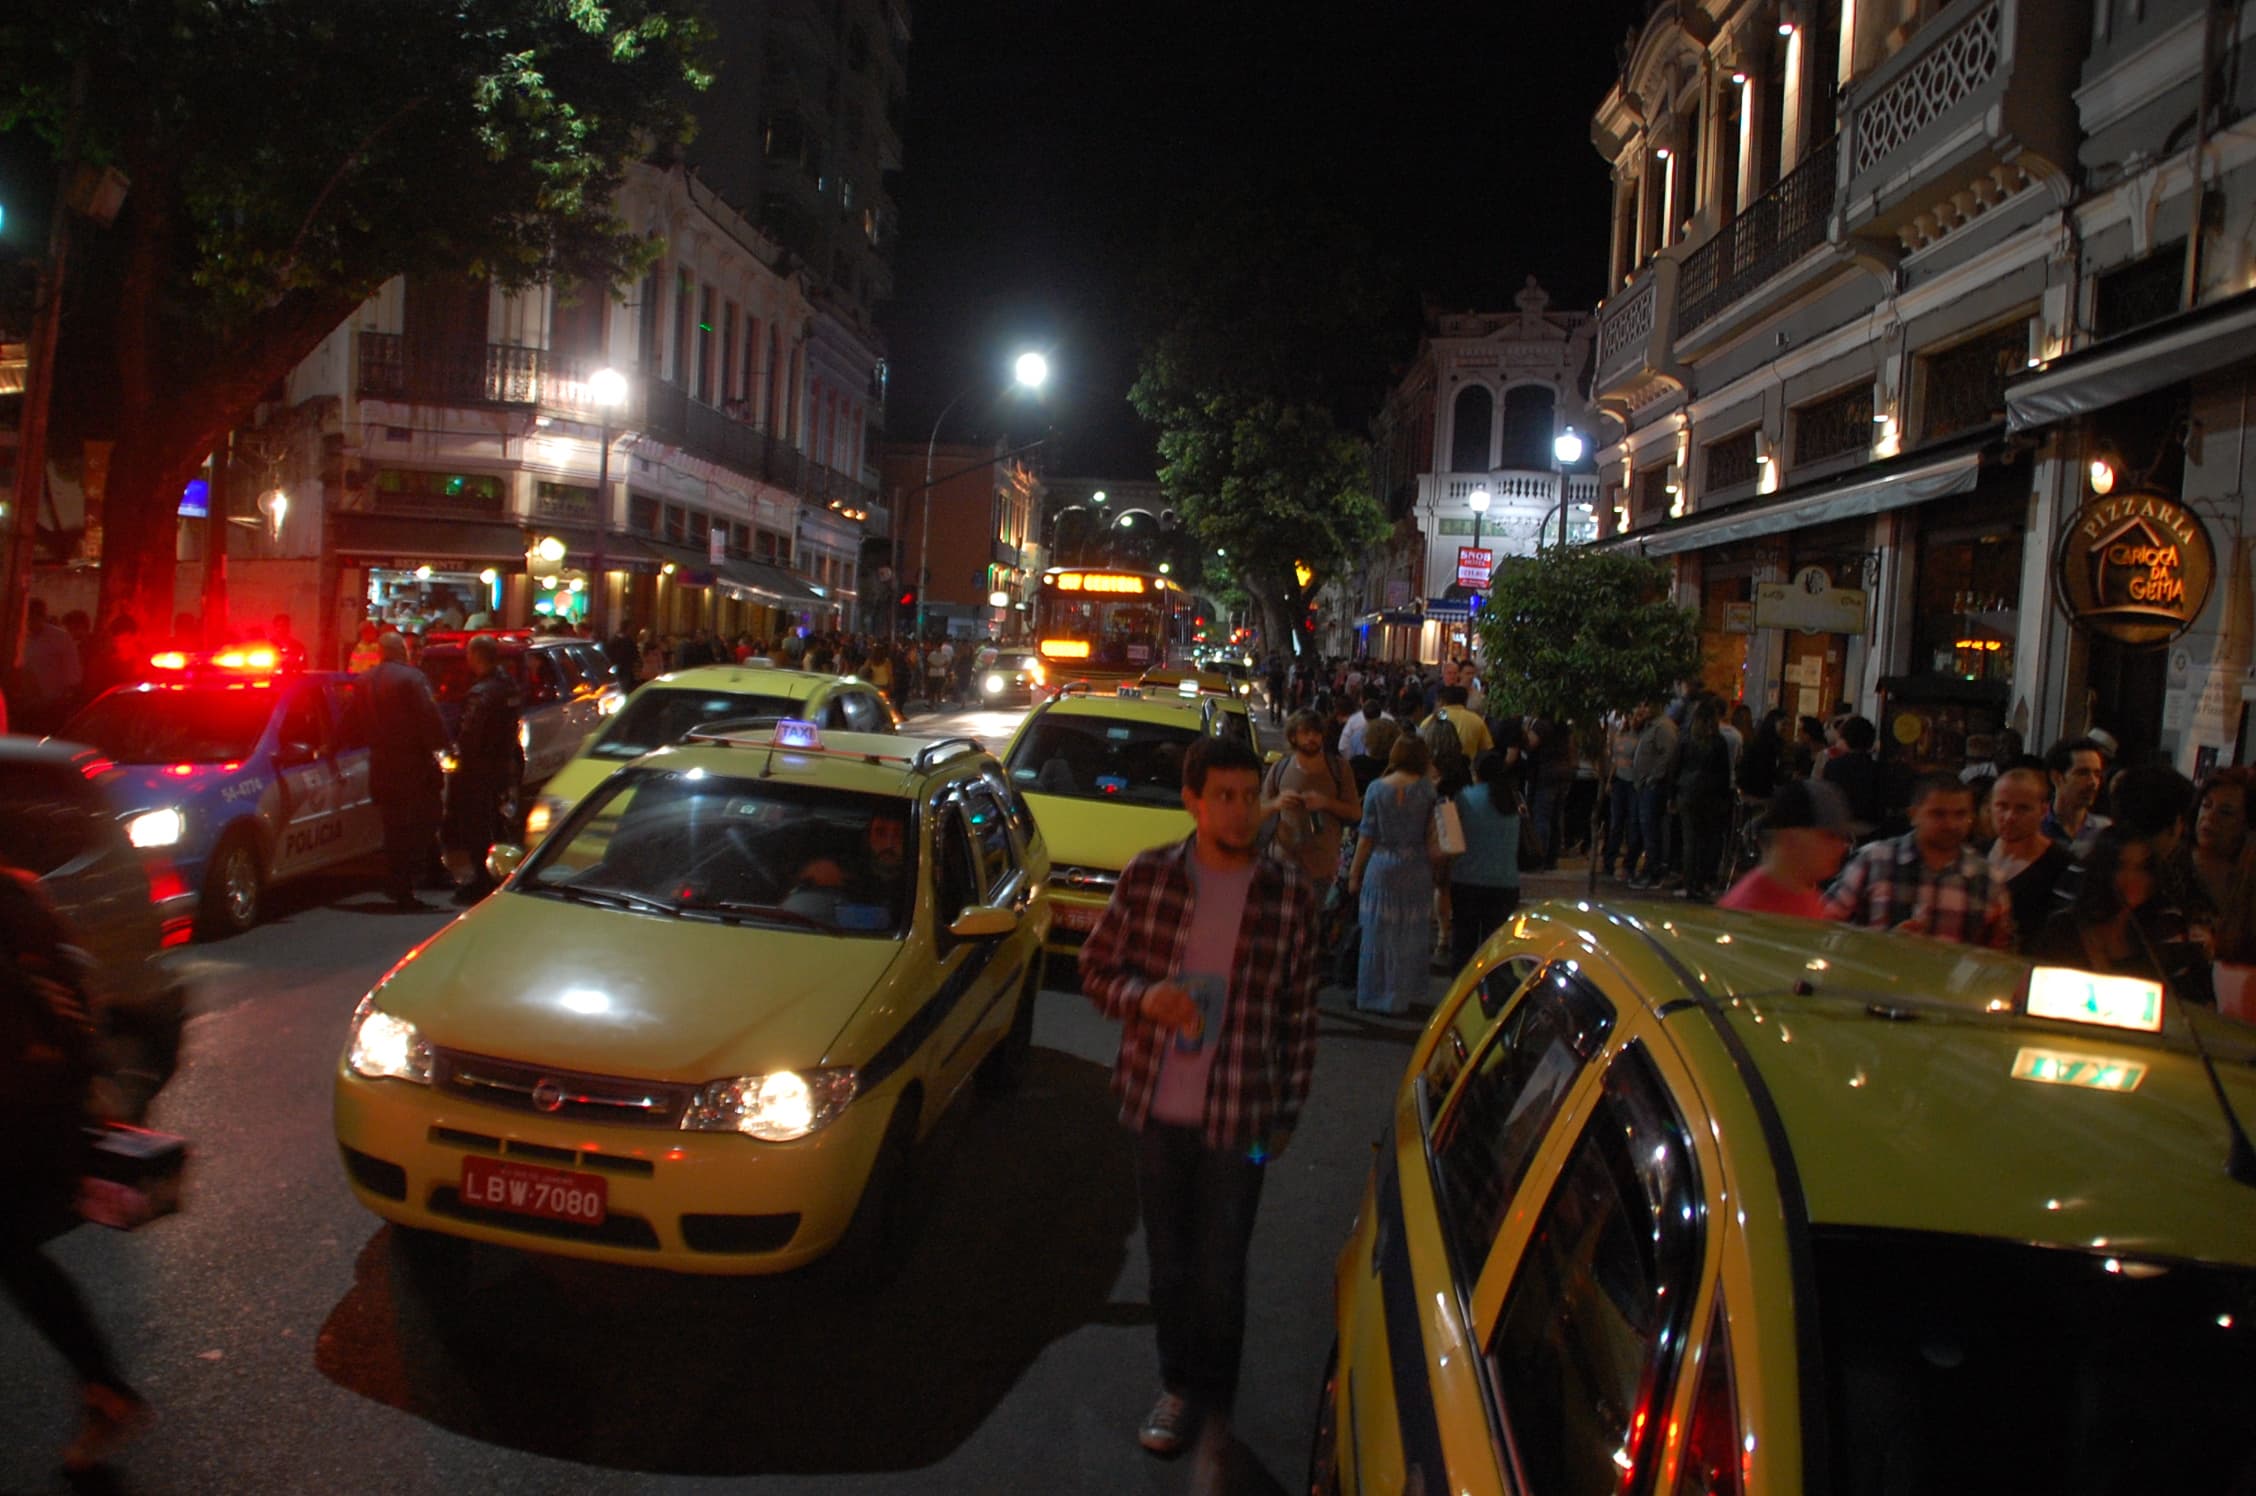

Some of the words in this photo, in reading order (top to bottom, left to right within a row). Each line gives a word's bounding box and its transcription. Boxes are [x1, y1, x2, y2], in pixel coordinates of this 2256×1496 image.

[2084, 499, 2195, 545] PIZZARIA
[2109, 544, 2179, 568] CARIOCA
[2151, 567, 2170, 581] DA
[2129, 576, 2184, 602] GEMA
[782, 725, 813, 739] TAXI
